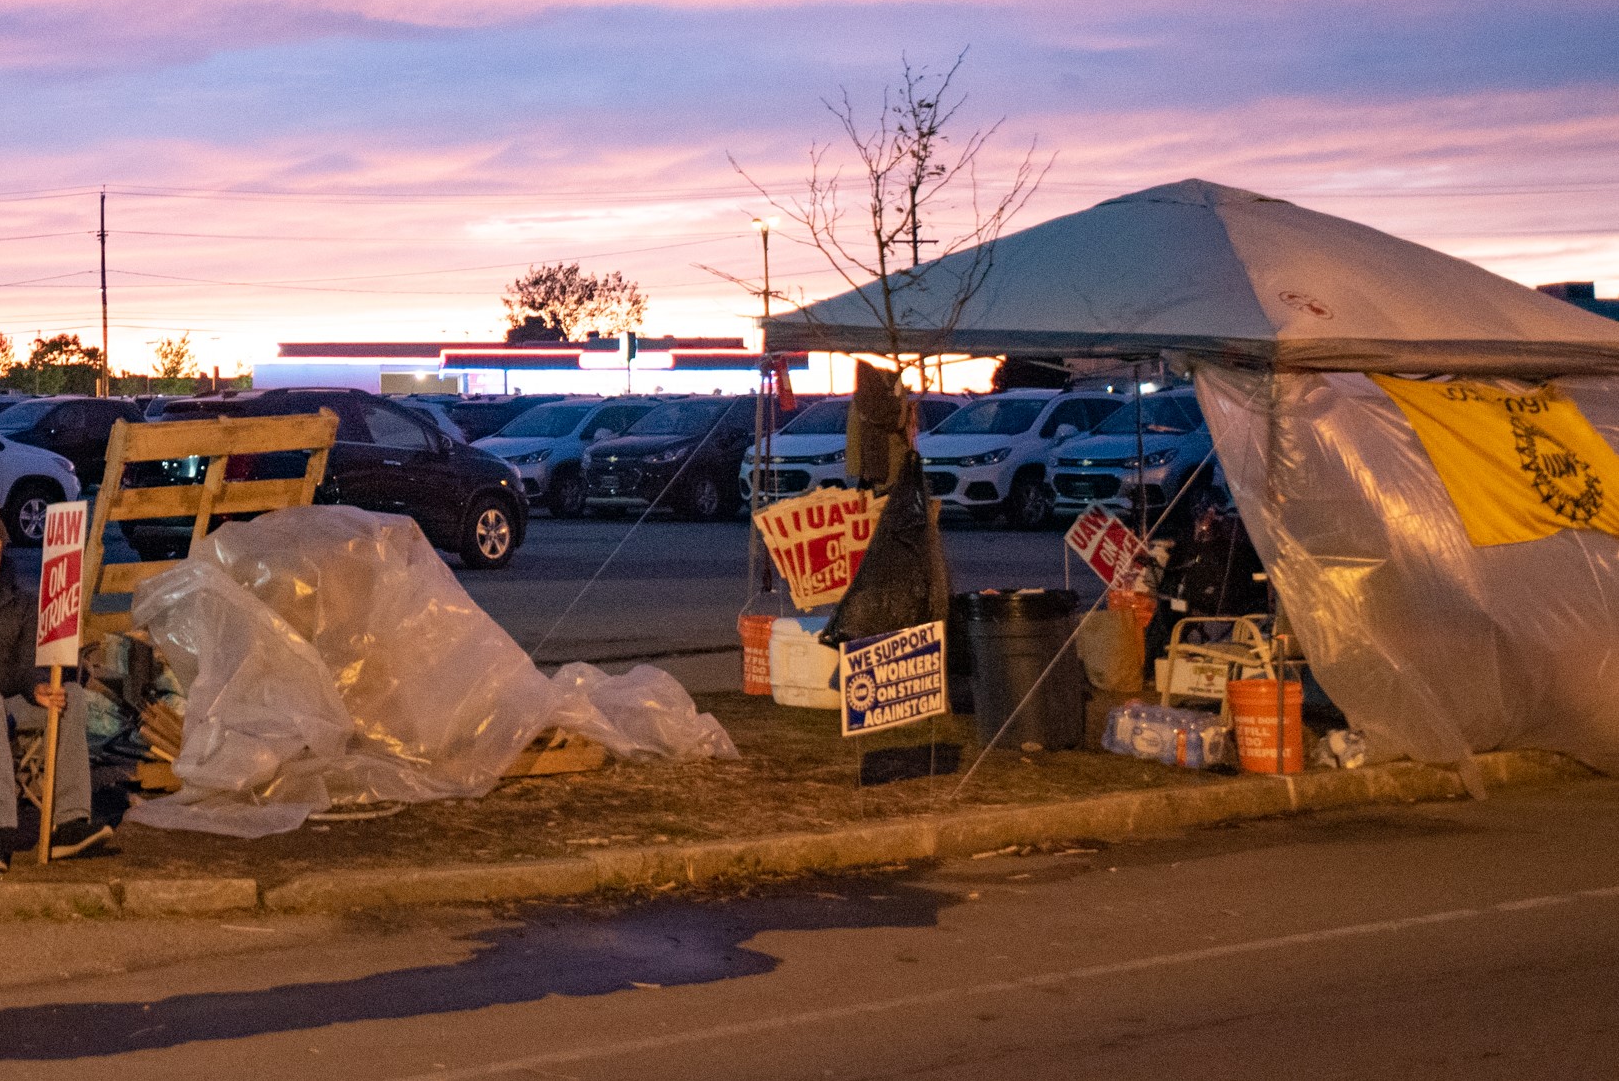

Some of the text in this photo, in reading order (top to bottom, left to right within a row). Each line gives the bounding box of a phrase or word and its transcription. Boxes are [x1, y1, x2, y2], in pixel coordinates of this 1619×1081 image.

[47, 510, 83, 547] UAW
[806, 496, 868, 529] UAW
[1070, 506, 1108, 550] UAW
[1099, 535, 1119, 566] ON
[49, 557, 68, 598] ON
[38, 582, 80, 643] STRIKE
[848, 624, 935, 671] WE SUPPORT
[874, 652, 940, 684] WORKERS
[876, 685, 897, 702] ON
[898, 673, 940, 697] STRIKE
[863, 693, 941, 727] AGAINST GM
